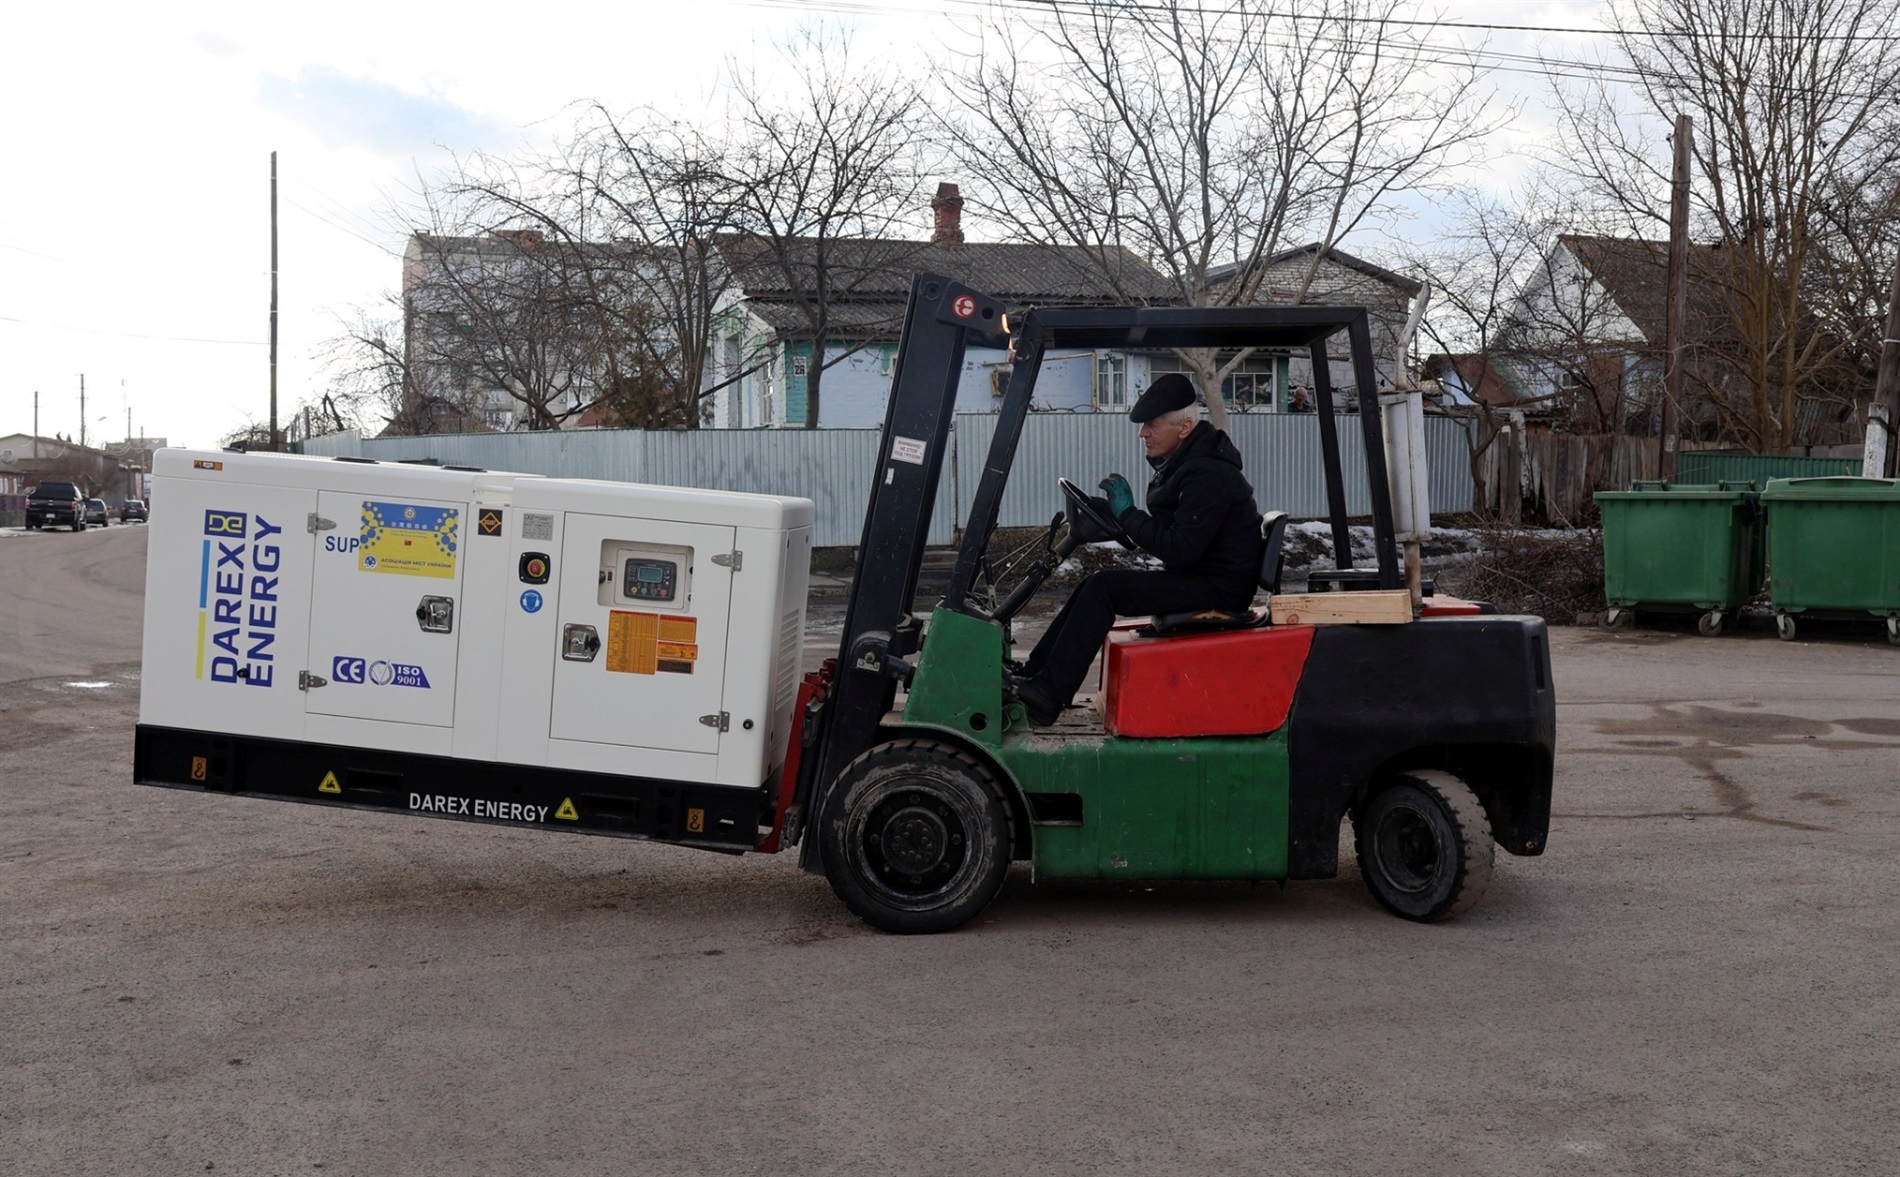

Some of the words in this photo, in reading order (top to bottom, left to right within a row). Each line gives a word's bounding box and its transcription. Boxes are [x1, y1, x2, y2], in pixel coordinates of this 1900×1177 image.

[211, 541, 246, 683] DAREX
[245, 514, 282, 687] ENERGY
[336, 659, 363, 683] CE
[397, 665, 420, 676] ISO
[397, 675, 421, 686] 9001
[409, 792, 470, 815] DAREX
[474, 799, 548, 823] ENERGY
